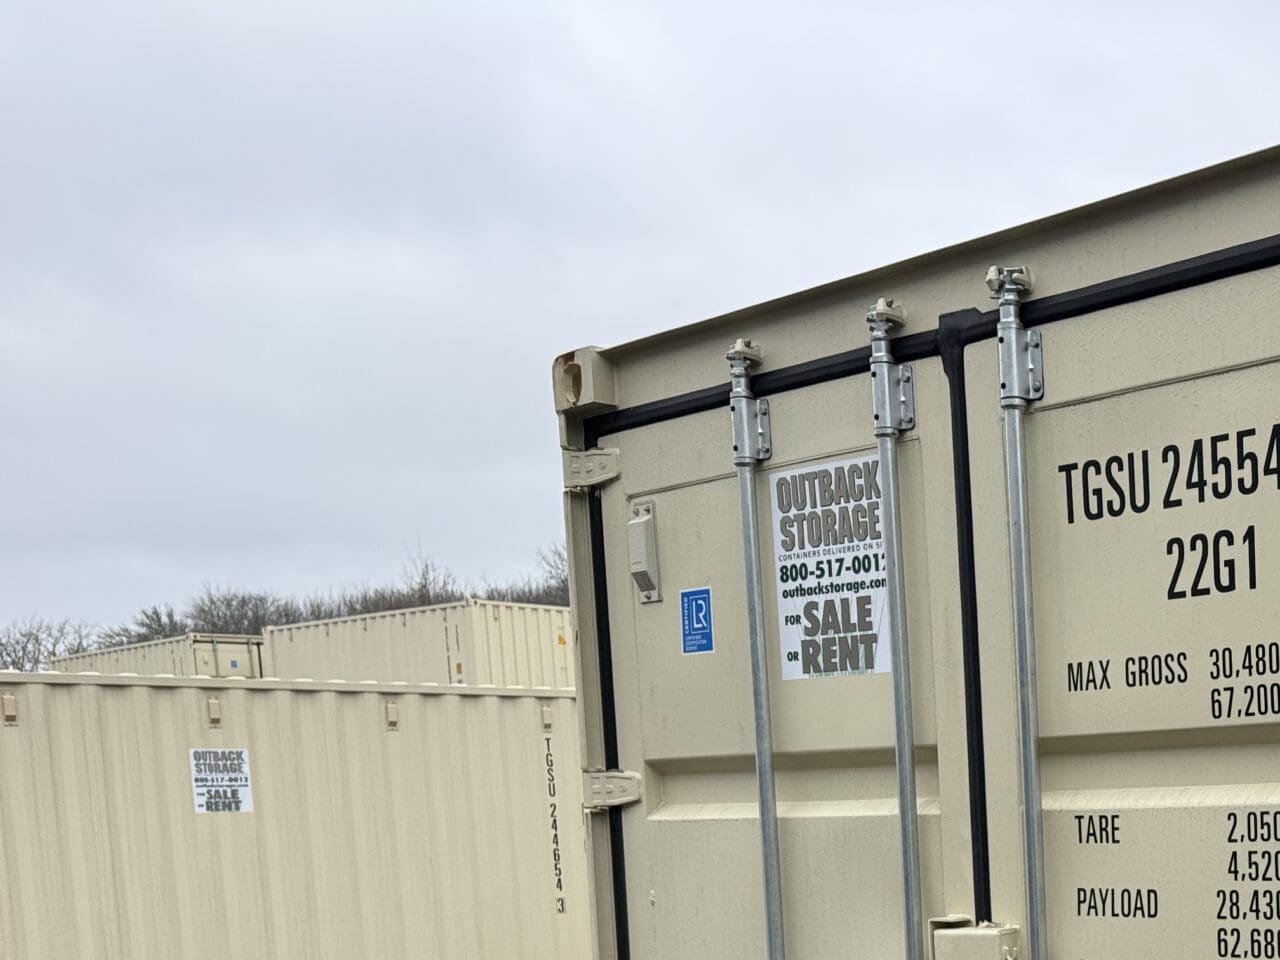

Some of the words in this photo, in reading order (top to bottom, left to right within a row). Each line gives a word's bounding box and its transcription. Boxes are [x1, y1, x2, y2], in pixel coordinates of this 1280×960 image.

[776, 460, 882, 514] OUTBACK
[1058, 449, 1151, 524] TGSU
[780, 501, 882, 552] STORAGE
[778, 551, 821, 562] CONTAINERS
[822, 545, 861, 556] DELIVERED
[863, 543, 874, 551] ON
[1166, 525, 1257, 600] 22G1
[785, 615, 802, 626] FOR
[803, 595, 873, 637] SALE
[787, 651, 799, 662] OR
[801, 633, 878, 675] RENT
[1067, 659, 1111, 692] MAX
[1124, 652, 1189, 688] GROSS
[1209, 642, 1280, 680] 30,480
[193, 750, 244, 762] OUTBACK
[194, 762, 244, 774] STORAGE
[545, 738, 556, 797] TGSU
[205, 800, 242, 812] RENT
[206, 788, 239, 800] SALE
[550, 803, 563, 891] 244654
[1075, 814, 1121, 844] TARE
[1077, 888, 1159, 918] PAYLOAD
